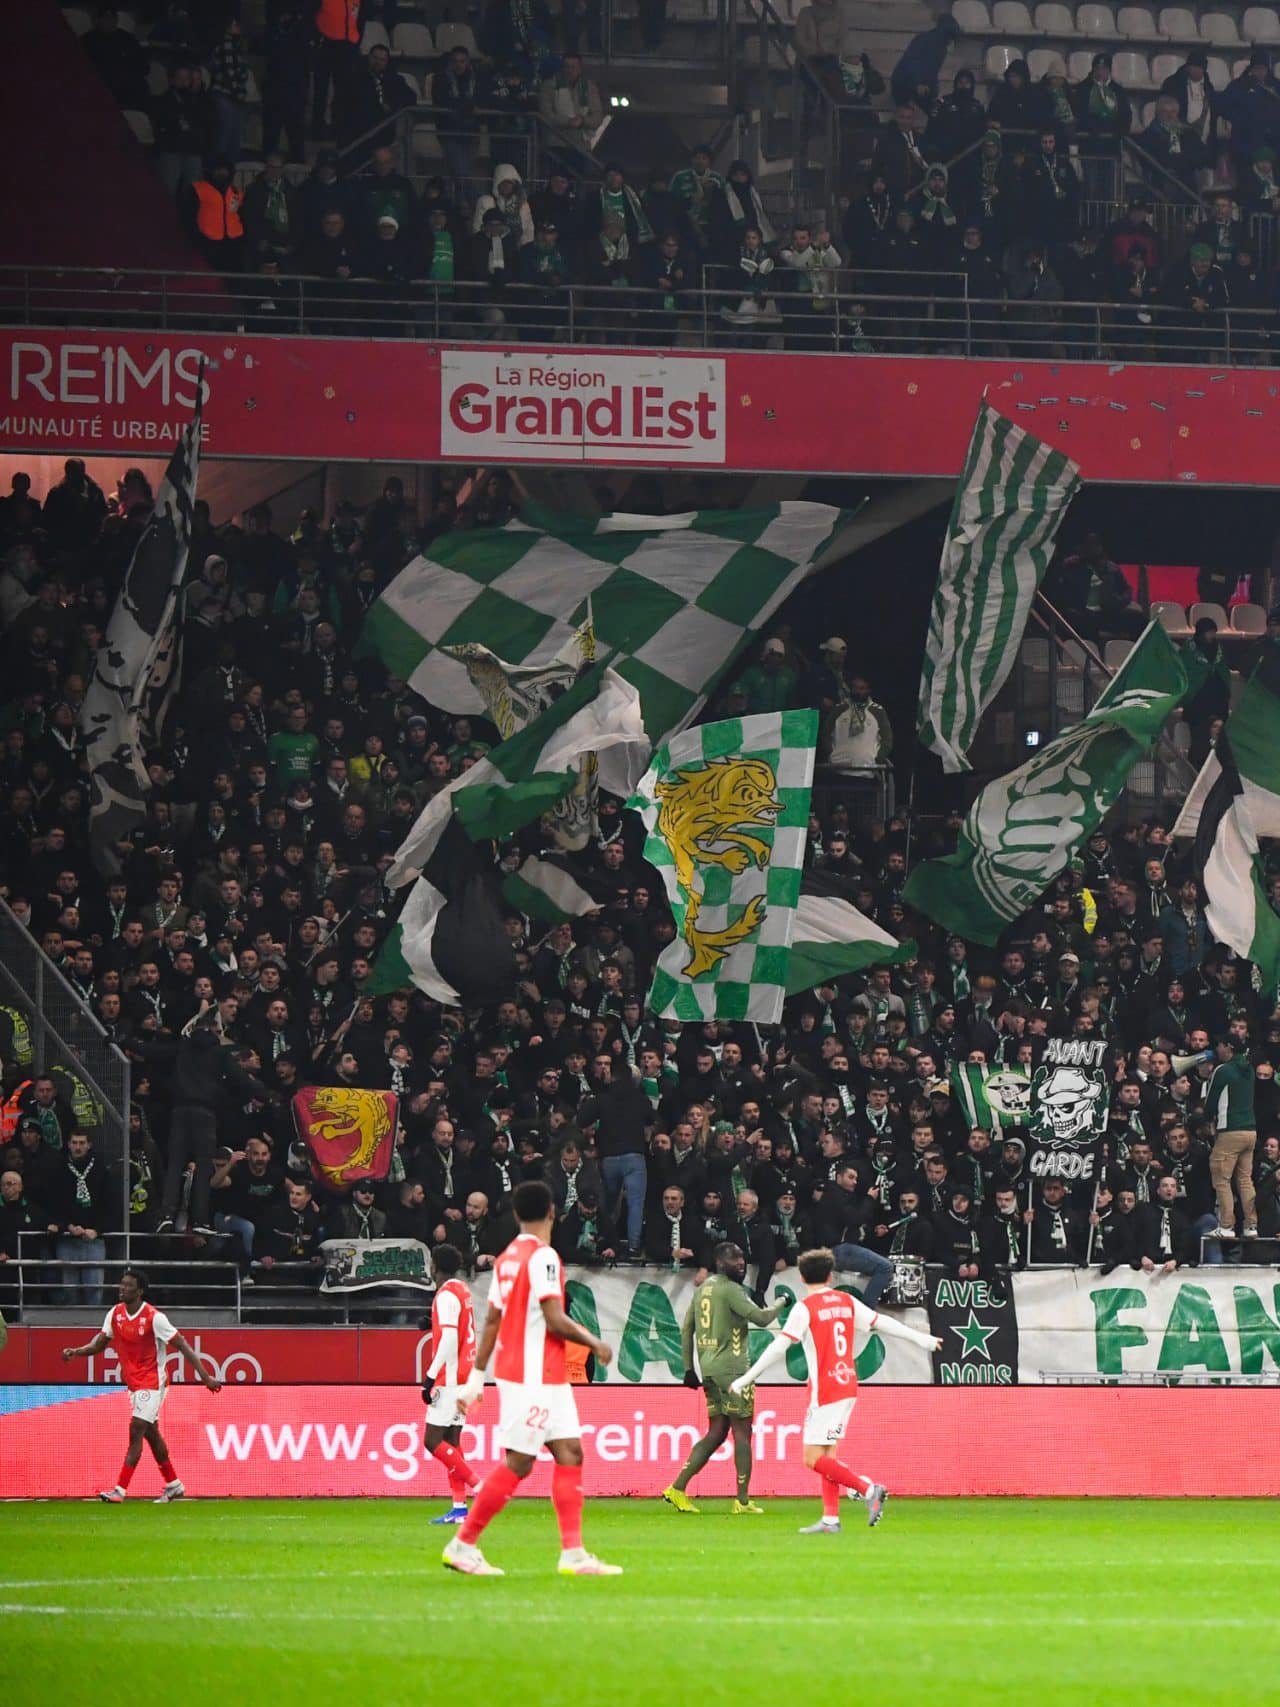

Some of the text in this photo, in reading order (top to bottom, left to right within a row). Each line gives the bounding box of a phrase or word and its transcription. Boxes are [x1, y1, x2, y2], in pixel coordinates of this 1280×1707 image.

[11, 342, 211, 409] REIMS
[495, 367, 605, 391] La Région
[450, 383, 717, 440] Grand Est
[1042, 1038, 1108, 1066] AVANT
[1030, 1150, 1095, 1180] GARDE
[701, 1298, 713, 1329] 3
[833, 1321, 847, 1357] 6
[940, 1362, 1011, 1384] NOUS
[526, 1405, 549, 1430] 22
